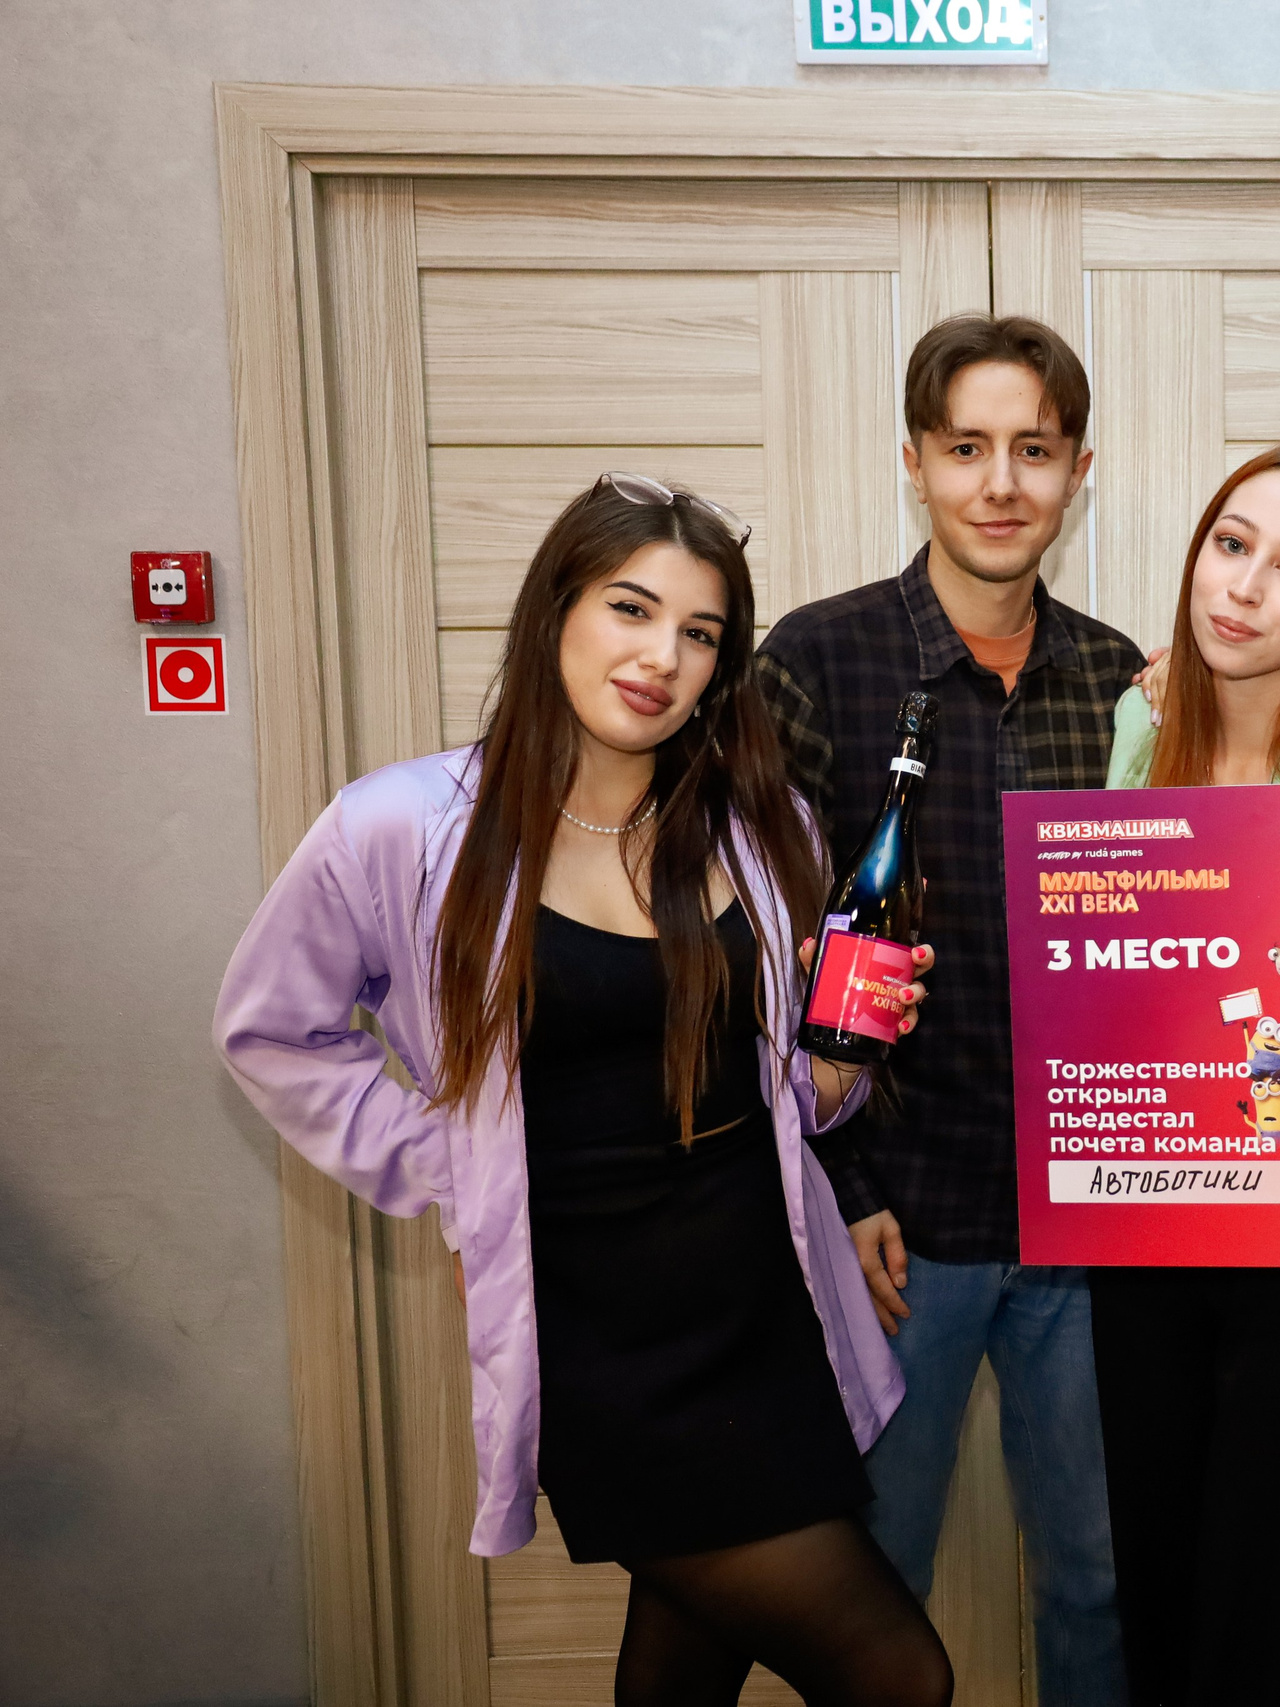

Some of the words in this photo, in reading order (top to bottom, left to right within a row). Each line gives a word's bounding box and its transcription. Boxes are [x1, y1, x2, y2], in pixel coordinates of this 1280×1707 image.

[821, 0, 1027, 43] ВЫХОД
[1037, 819, 1195, 842] КВИЗМАШИНА
[1037, 851, 1071, 860] CREATED
[1071, 851, 1083, 860] BY
[1085, 847, 1108, 858] rudá
[1110, 849, 1144, 859] games
[1039, 868, 1231, 892] МУЛЬТФИЛЬМЫ
[1081, 892, 1140, 914] ВЕКА
[1047, 940, 1072, 971] 3
[1085, 936, 1241, 970] МЕСТО
[1046, 1058, 1252, 1083] Торжественно
[1047, 1086, 1168, 1109] открыла
[1049, 1111, 1195, 1131] пьедестал
[1050, 1136, 1146, 1152] почета
[1154, 1135, 1277, 1156] команда
